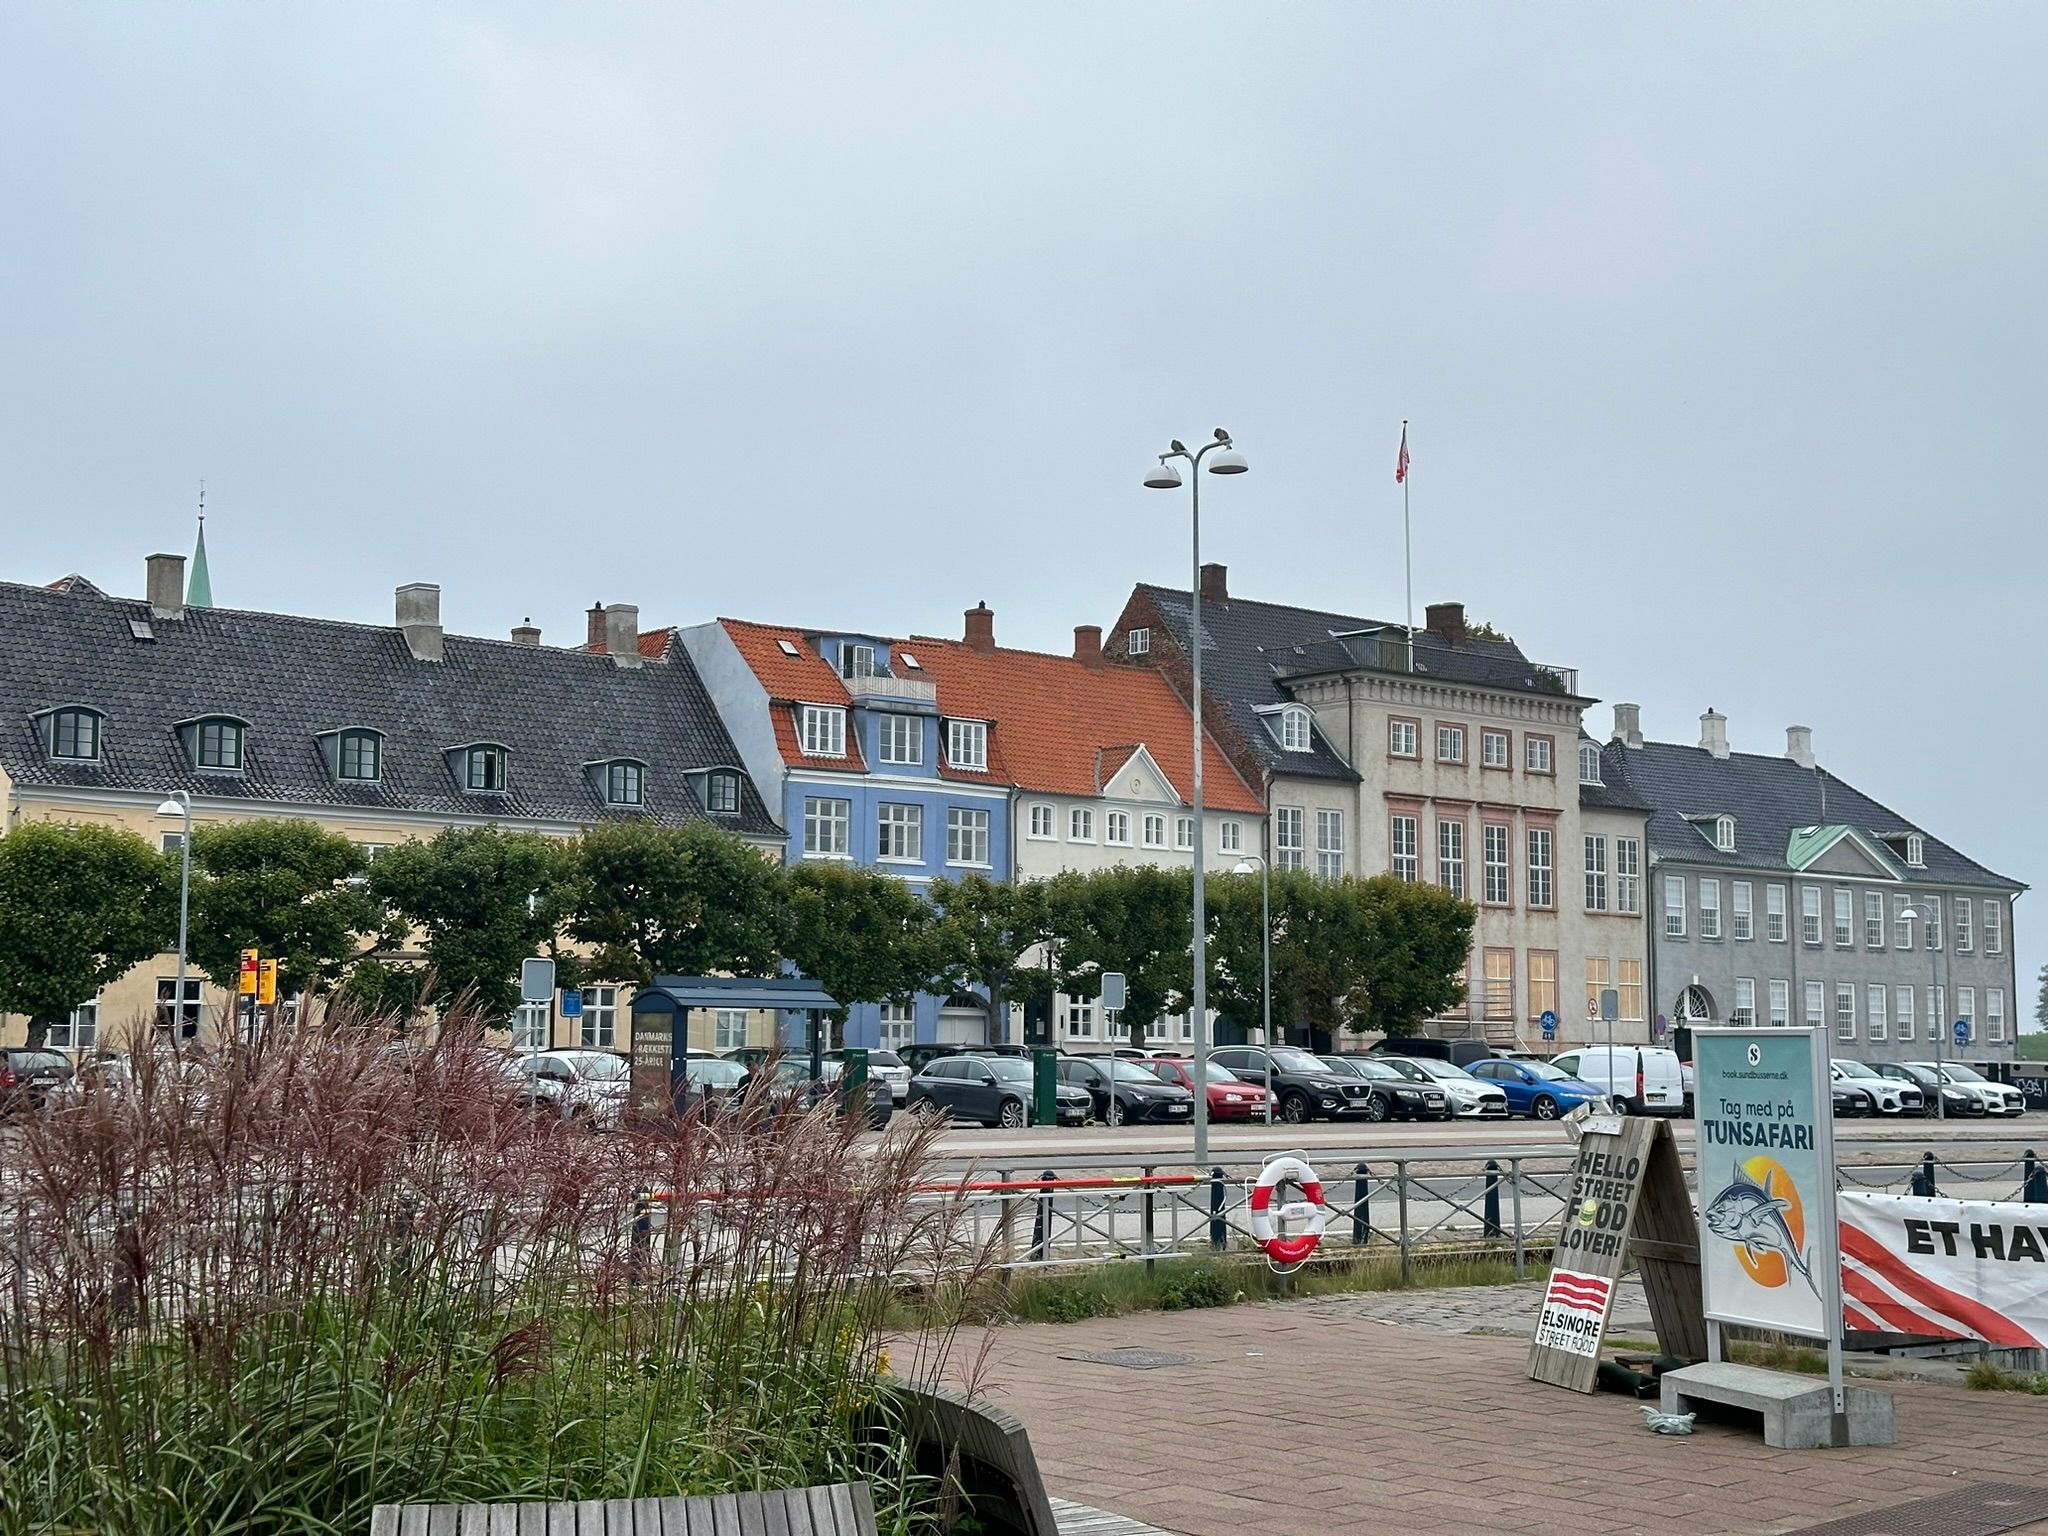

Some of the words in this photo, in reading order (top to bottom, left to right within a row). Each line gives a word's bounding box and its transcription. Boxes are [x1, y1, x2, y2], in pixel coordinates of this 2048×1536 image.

[635, 1031, 673, 1042] DANMARKS
[1722, 1070, 1789, 1080] book.sundbusserne.dk
[1719, 1098, 1741, 1119] Tag
[1746, 1101, 1773, 1117] med
[1777, 1100, 1795, 1120] på
[1703, 1119, 1814, 1150] TUNSAFARI
[1577, 1150, 1640, 1181] HELLO
[1572, 1175, 1636, 1203] STREET
[1565, 1196, 1628, 1232] FOD
[1559, 1226, 1622, 1258] LOVER!
[1903, 1218, 1960, 1257] ET
[1541, 1310, 1600, 1337] ELSINORE
[1538, 1328, 1572, 1348] STREET
[1571, 1336, 1596, 1354] FOOD
